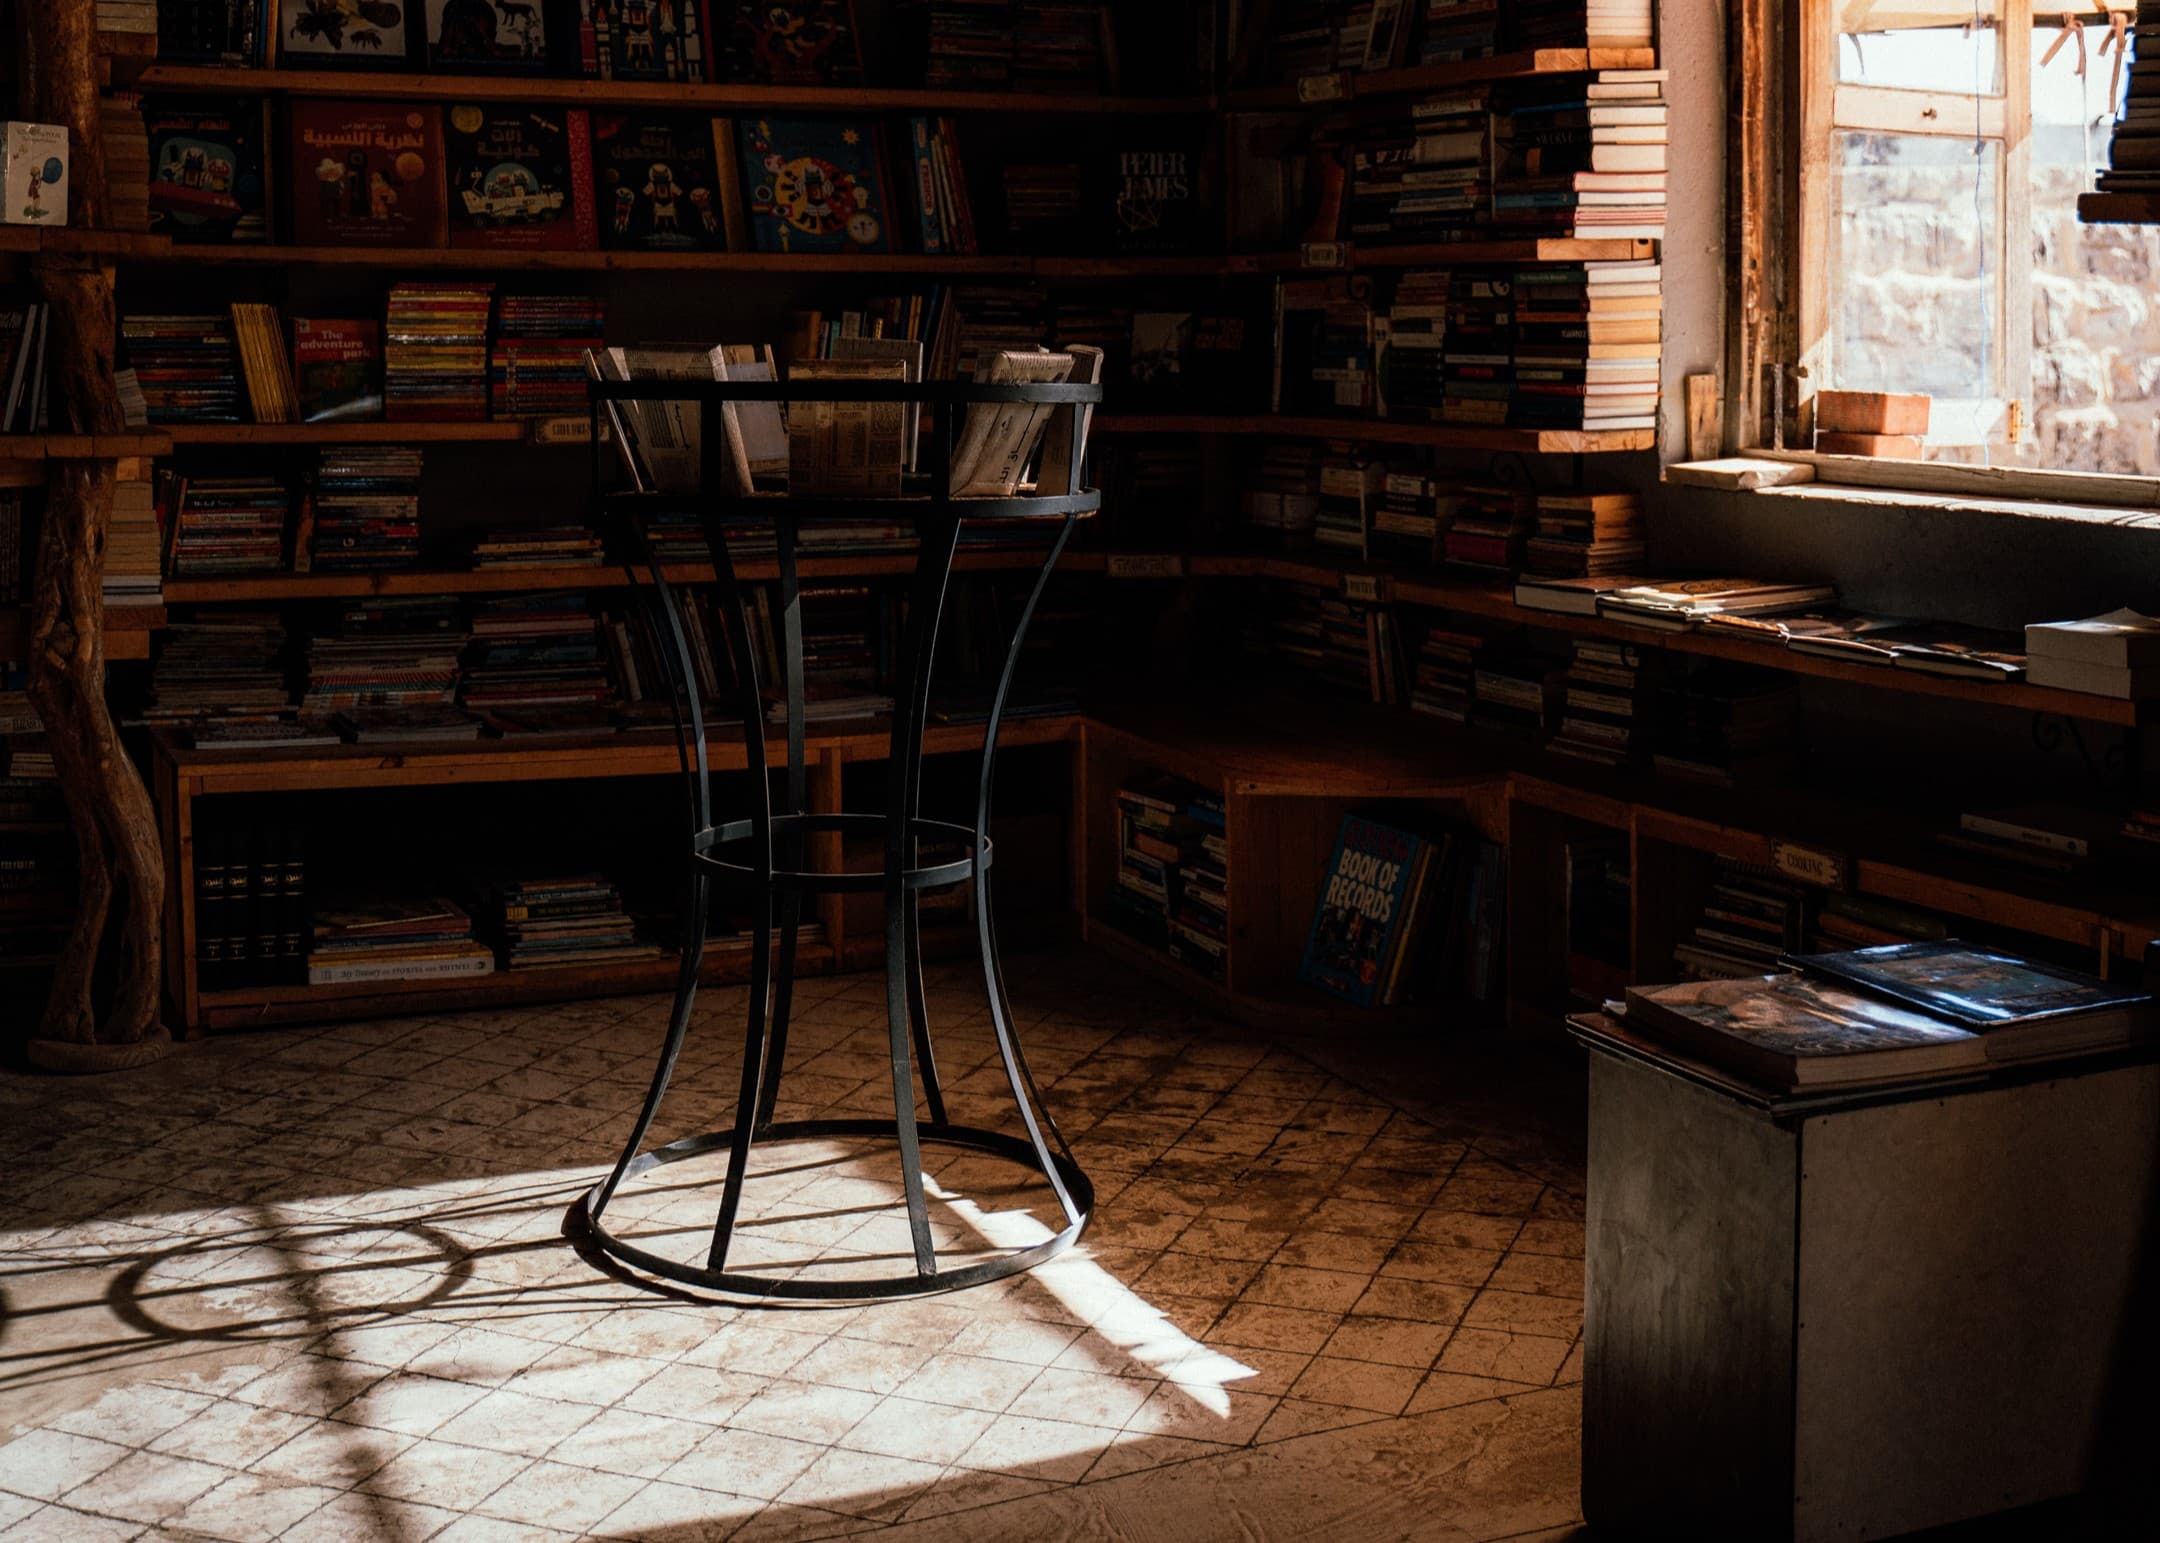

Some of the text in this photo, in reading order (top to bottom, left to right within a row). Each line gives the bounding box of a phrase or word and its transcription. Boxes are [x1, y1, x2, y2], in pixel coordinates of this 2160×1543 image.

[1119, 151, 1187, 175] PETER
[1121, 175, 1189, 200] JAMES
[300, 338, 364, 350] adventure
[321, 330, 344, 340] The
[343, 349, 370, 361] park
[1338, 848, 1401, 892] BOOK OF
[1786, 853, 1823, 875] COOKING
[1326, 875, 1395, 924] RECORDS
